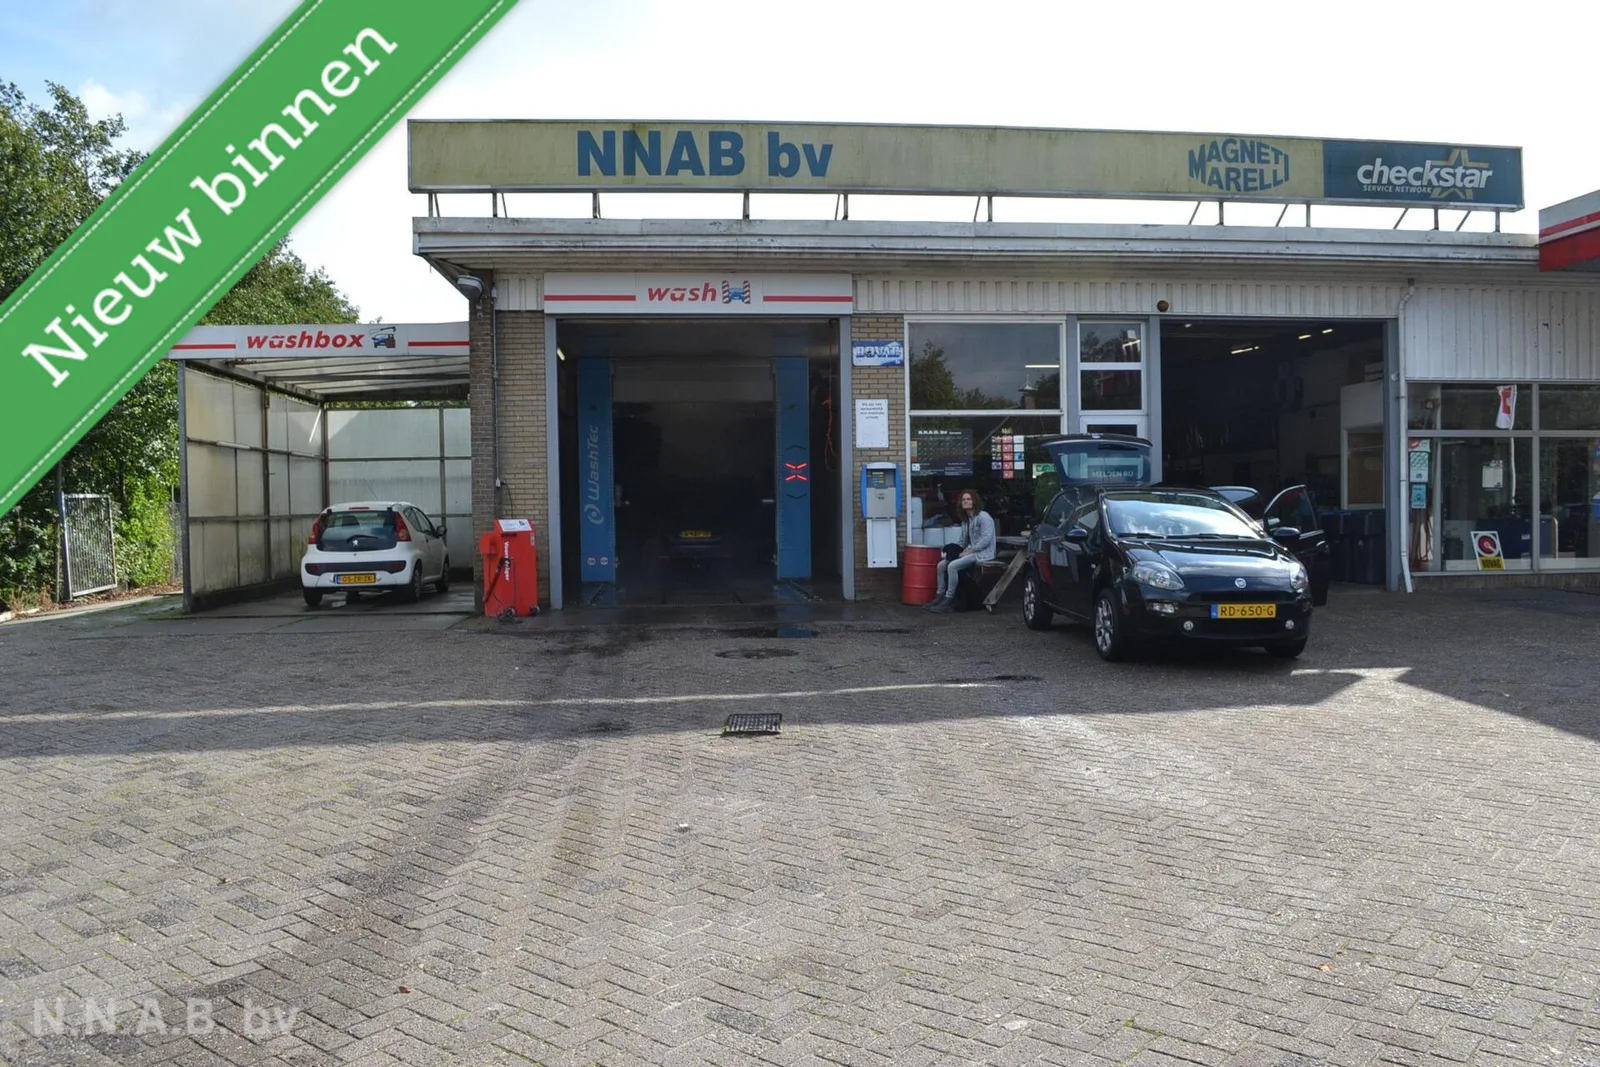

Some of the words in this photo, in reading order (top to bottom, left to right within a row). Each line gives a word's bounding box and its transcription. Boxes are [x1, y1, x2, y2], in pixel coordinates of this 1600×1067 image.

[577, 130, 745, 176] NNAB
[768, 131, 833, 177] bv
[1188, 138, 1290, 170] MAGNETI
[1188, 162, 1290, 192] MARELLI
[1356, 157, 1494, 188] checkstar
[1363, 184, 1393, 193] SERVICE
[1395, 186, 1433, 194] NETWORK
[647, 281, 717, 303] wash
[247, 330, 365, 349] washbox
[1220, 605, 1274, 617] RD-650-G
